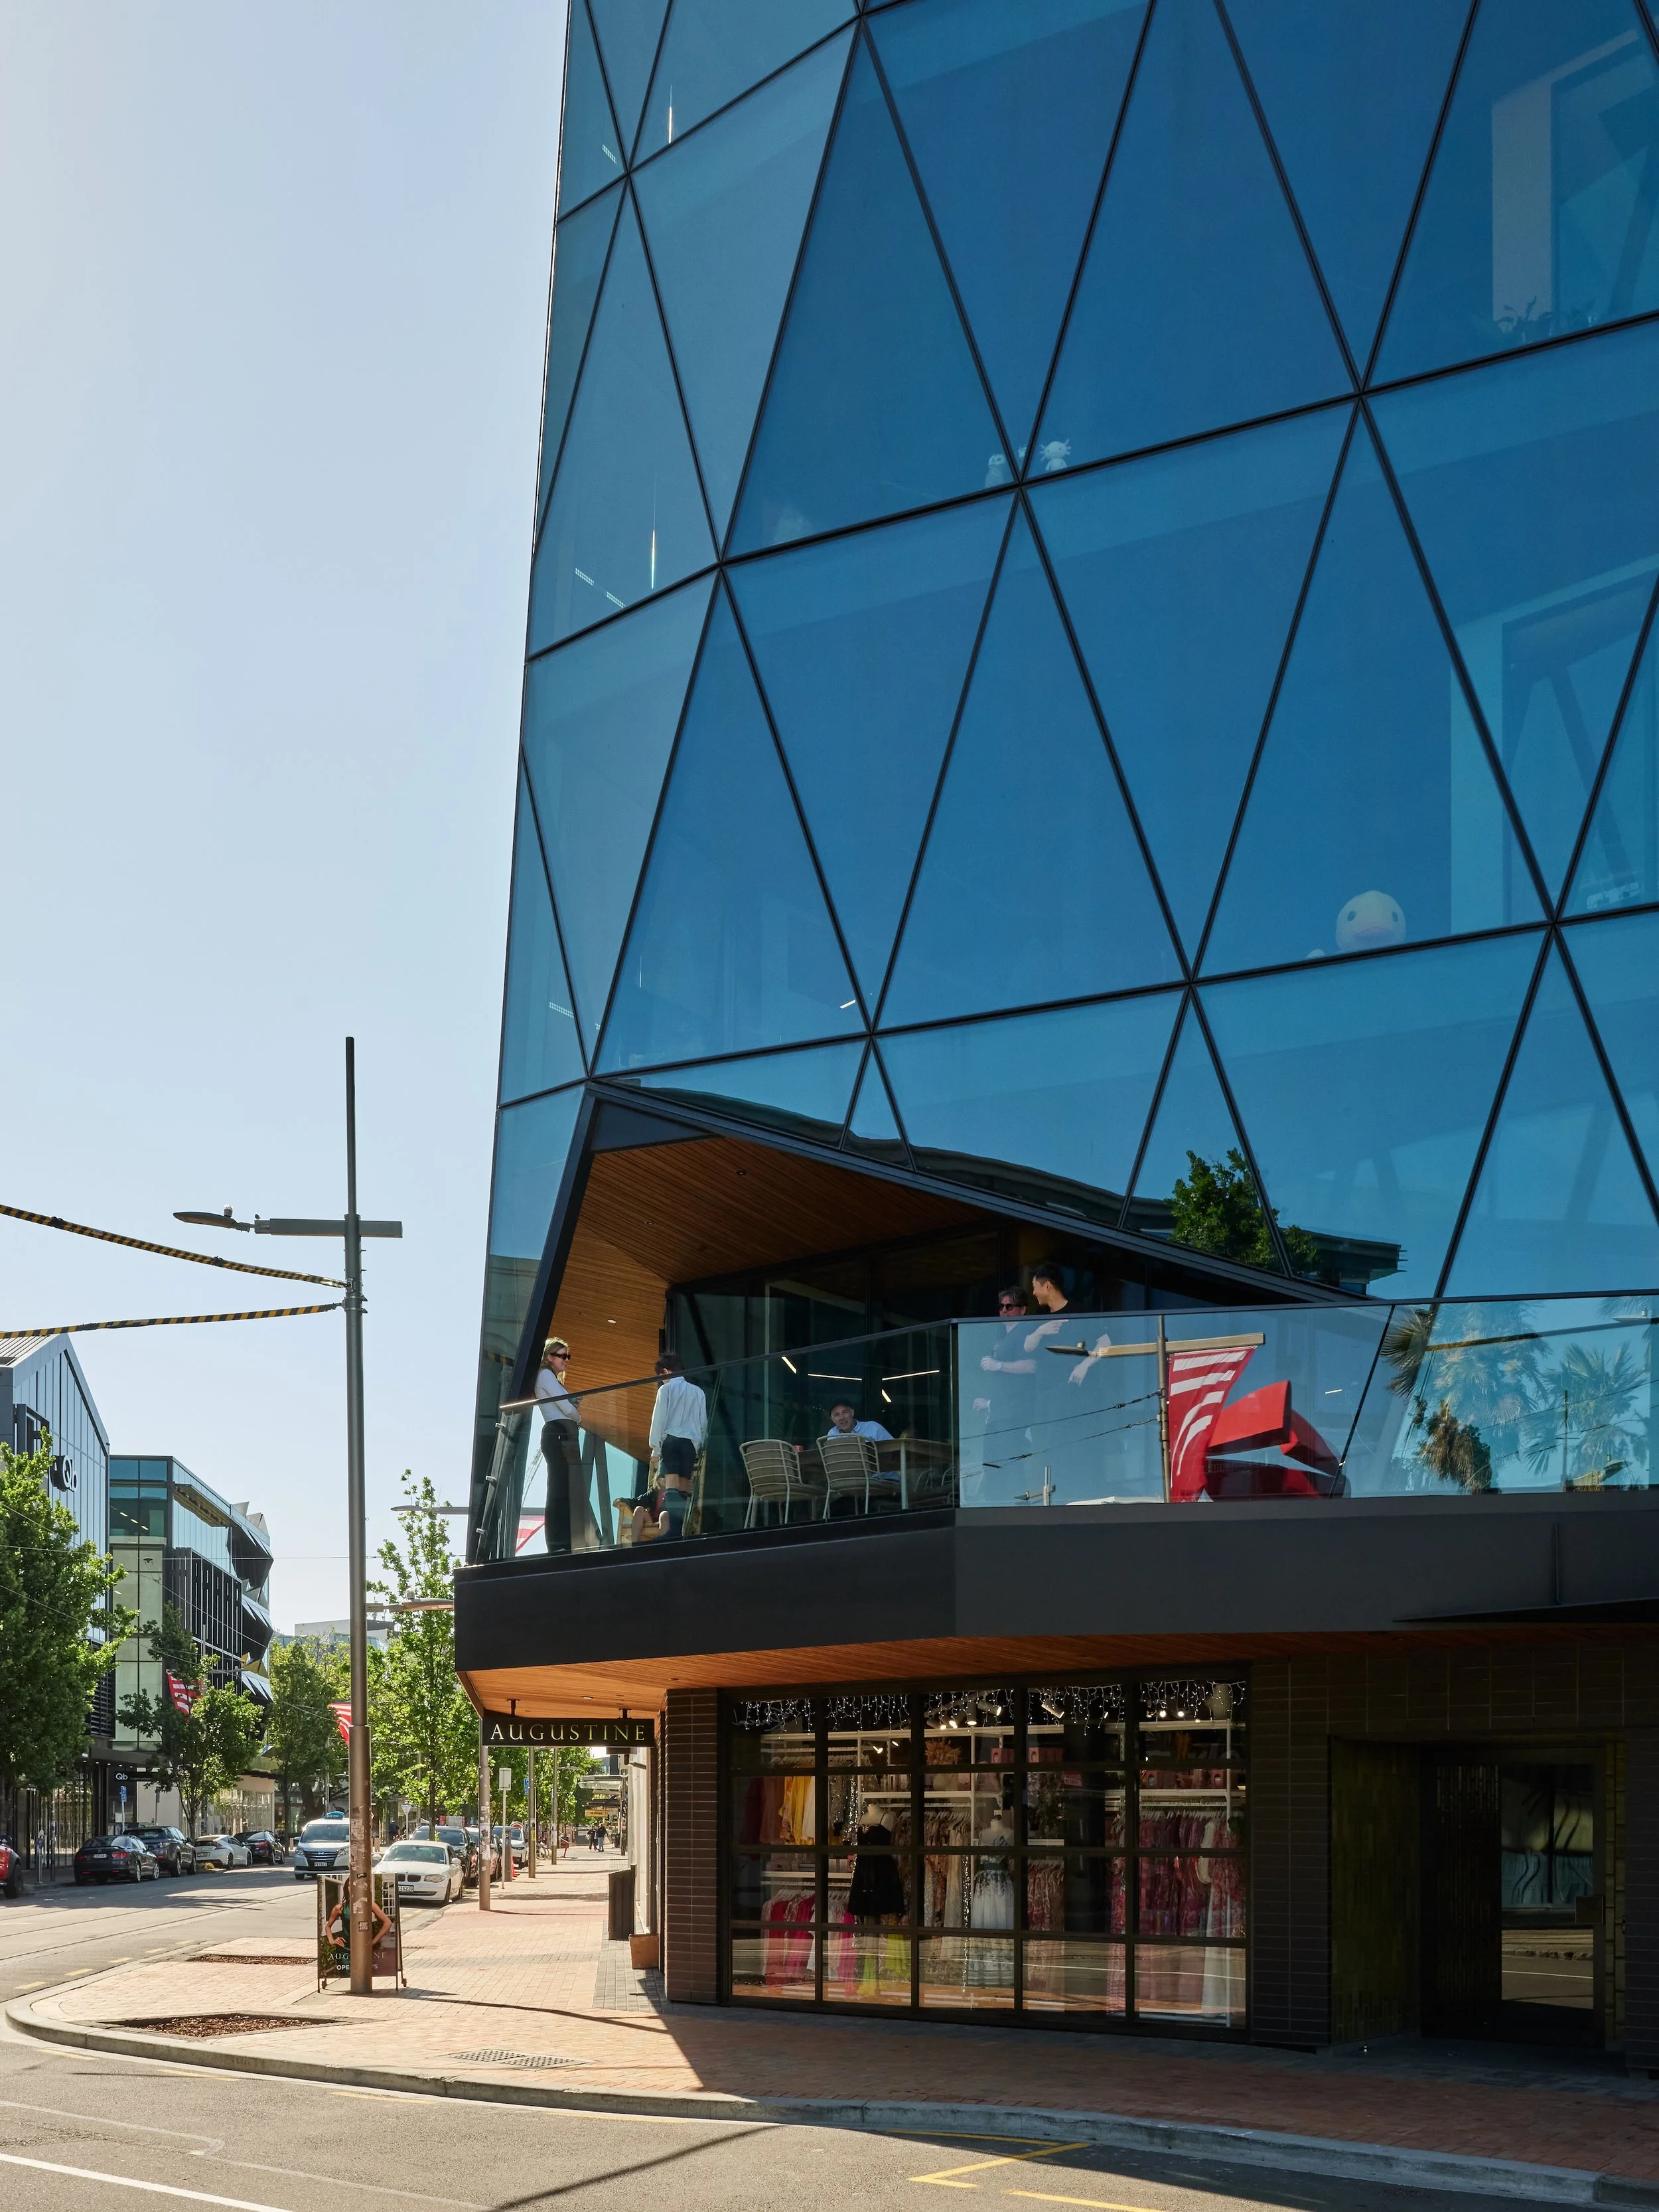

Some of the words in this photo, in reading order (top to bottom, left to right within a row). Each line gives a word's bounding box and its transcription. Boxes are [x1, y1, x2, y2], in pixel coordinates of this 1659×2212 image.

[62, 1455, 78, 1492] Qb
[490, 1723, 645, 1741] AUGUSTINE
[328, 1952, 386, 1960] AUGNE
